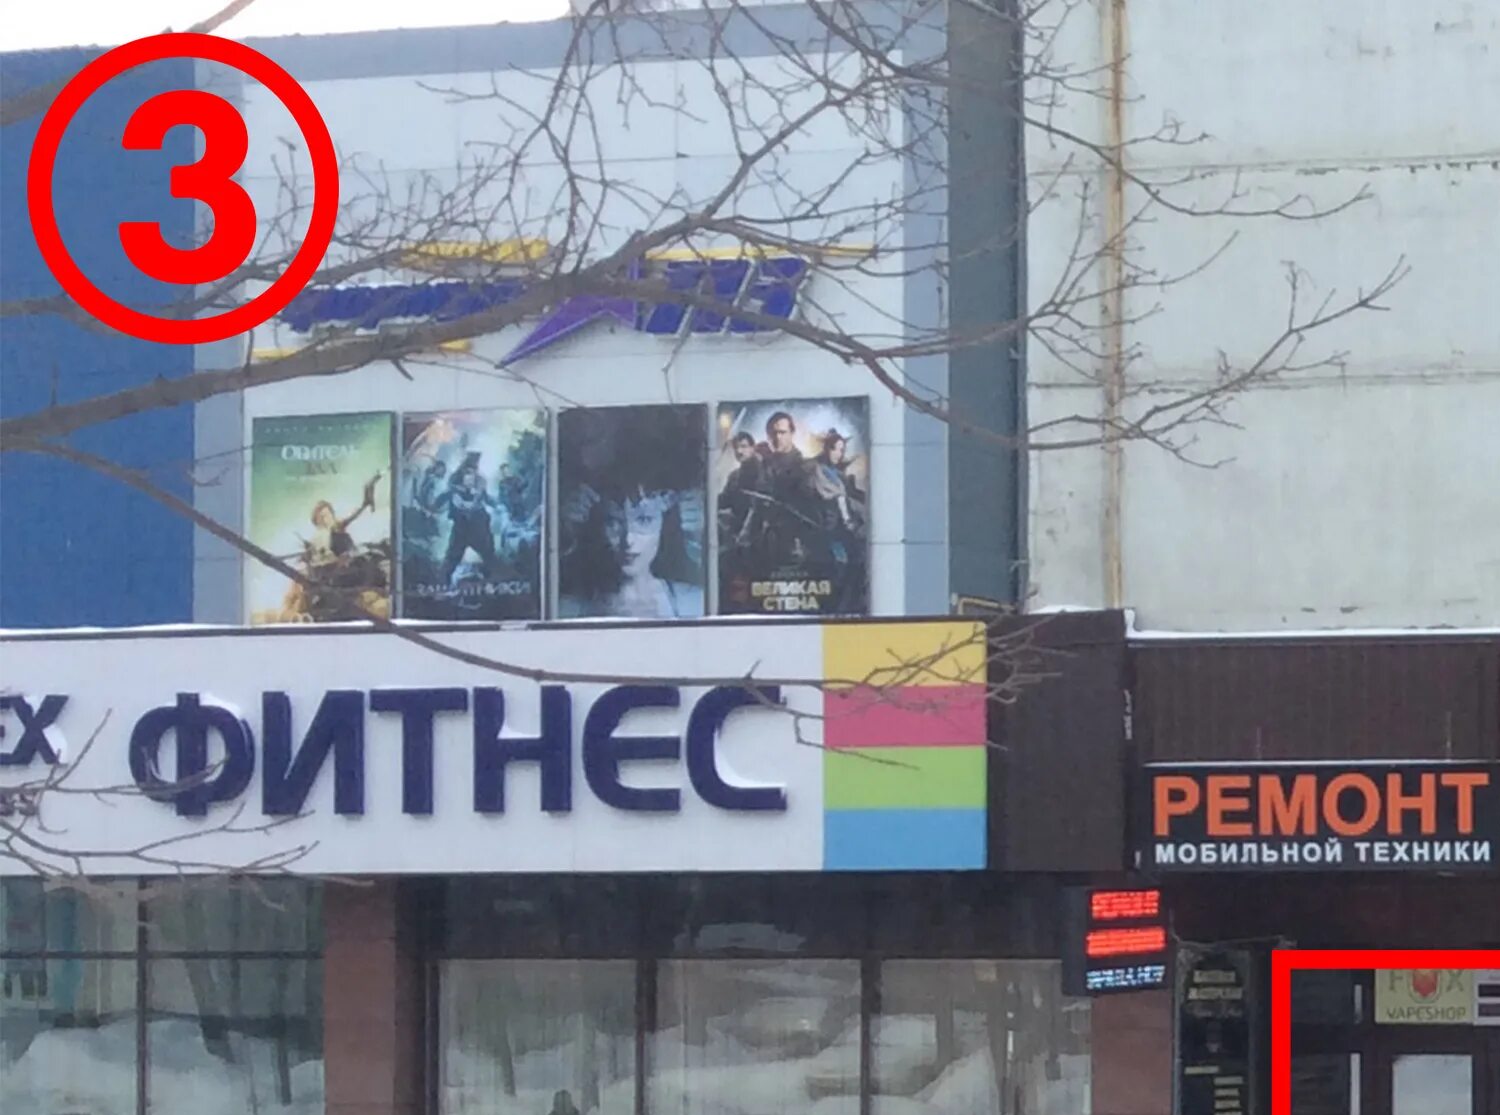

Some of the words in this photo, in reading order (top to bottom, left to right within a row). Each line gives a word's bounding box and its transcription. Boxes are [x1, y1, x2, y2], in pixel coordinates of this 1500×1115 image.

[752, 580, 831, 596] ВЕЛИКАЯ
[763, 596, 819, 611] СТЕНА
[128, 682, 787, 817] ФИТНЕС
[1153, 772, 1490, 836] РЕМОНТ
[1155, 838, 1342, 864] МОБИЛЬНОЙ
[1354, 839, 1491, 863] ТЕХНИКИ
